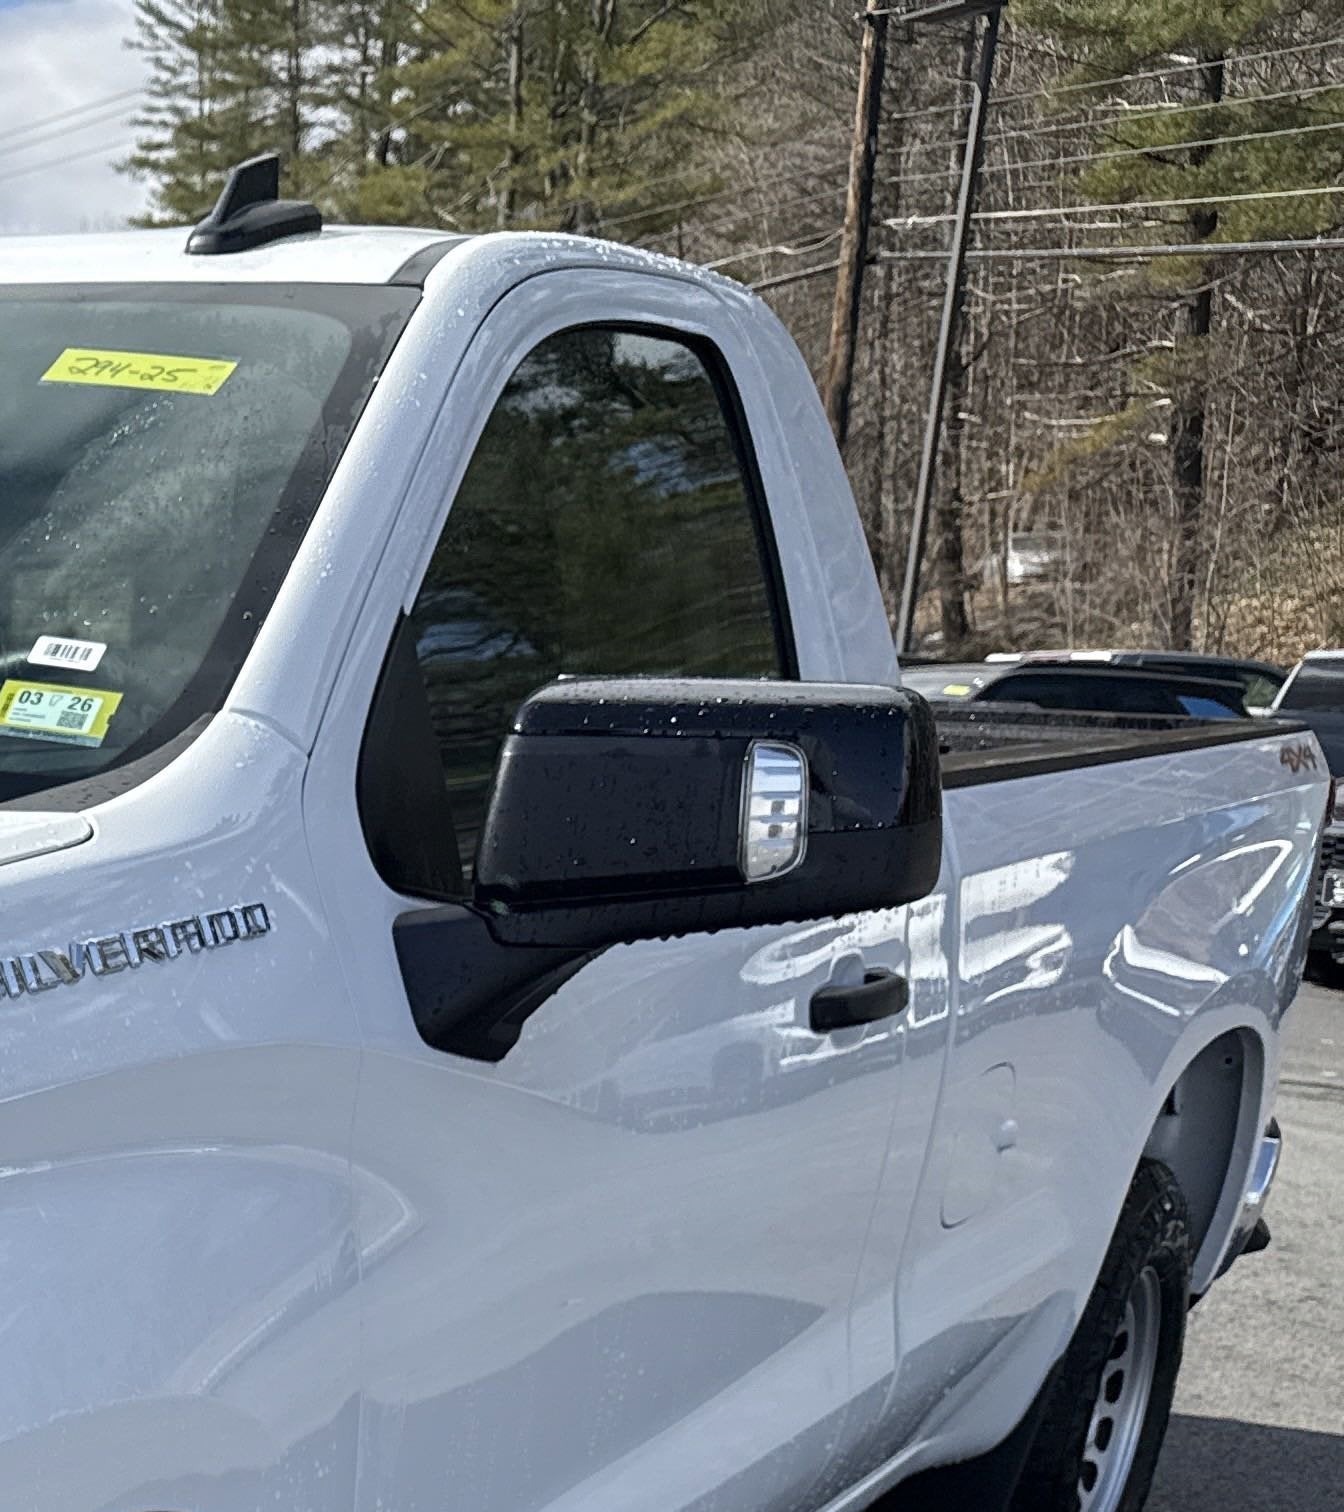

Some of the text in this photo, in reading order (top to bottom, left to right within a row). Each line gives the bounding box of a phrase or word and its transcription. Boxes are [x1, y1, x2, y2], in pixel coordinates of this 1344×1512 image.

[67, 356, 198, 384] 294-25
[18, 690, 44, 706] 03
[67, 696, 95, 712] 26
